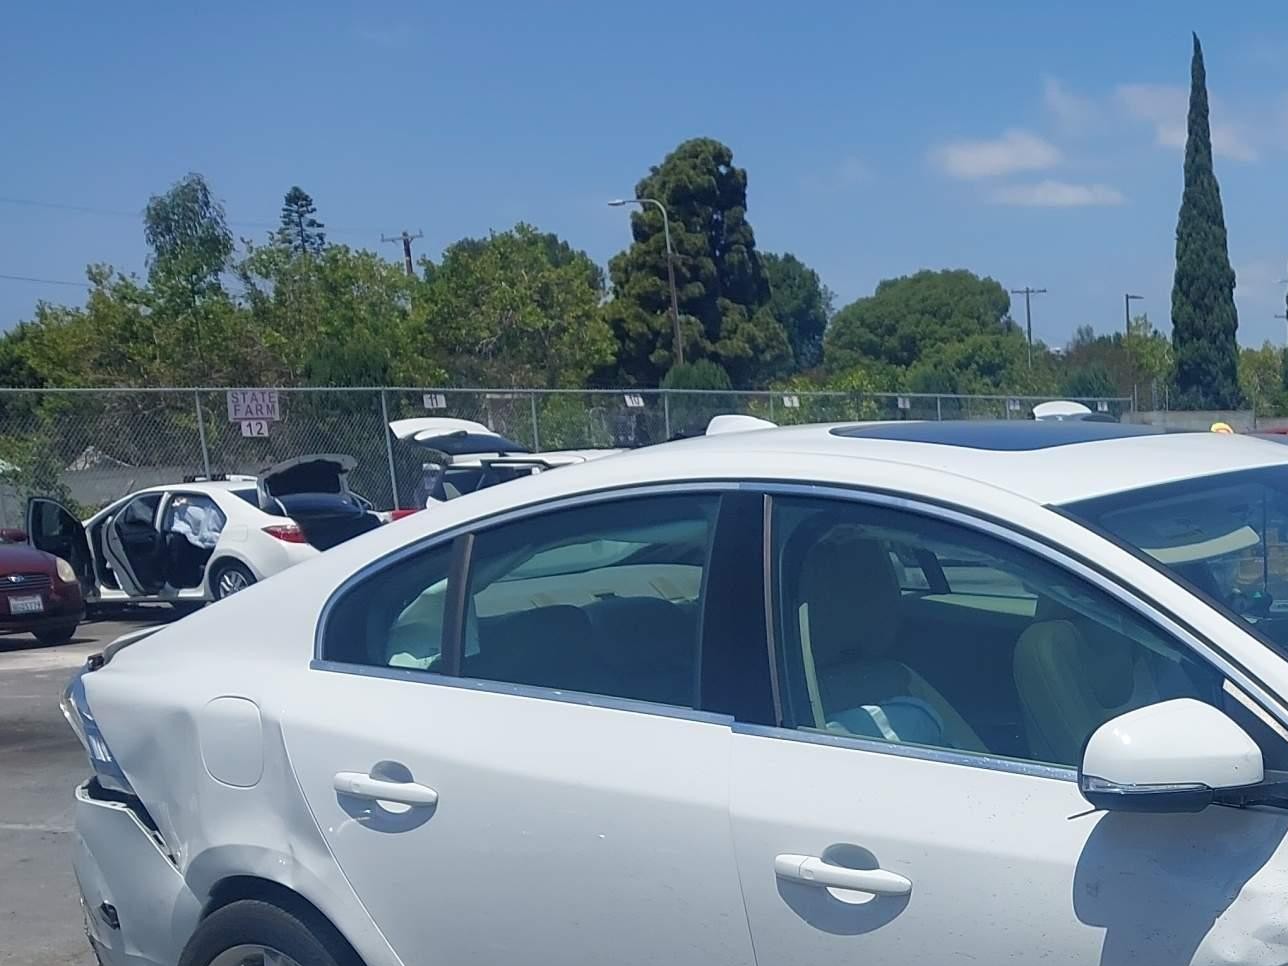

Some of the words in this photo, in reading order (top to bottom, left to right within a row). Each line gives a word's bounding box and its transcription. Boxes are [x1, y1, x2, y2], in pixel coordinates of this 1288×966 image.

[231, 391, 276, 404] STATE
[234, 403, 276, 417] FARM
[246, 421, 265, 436] 12
